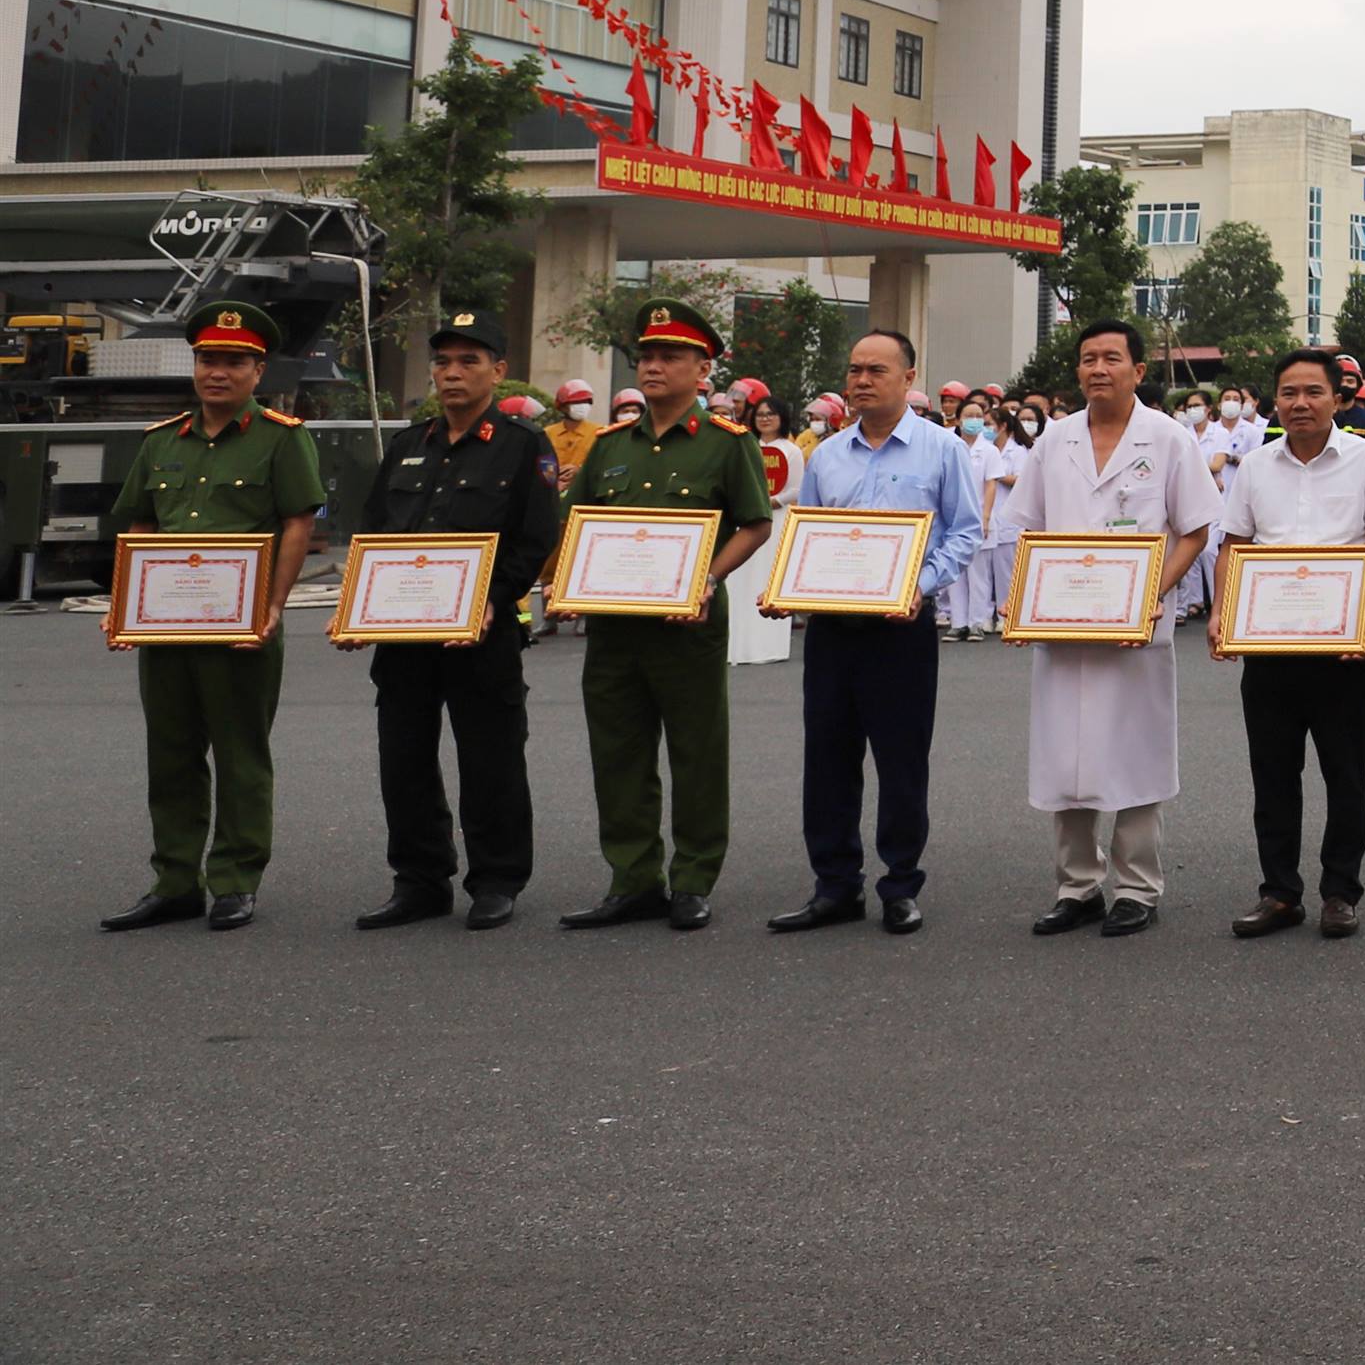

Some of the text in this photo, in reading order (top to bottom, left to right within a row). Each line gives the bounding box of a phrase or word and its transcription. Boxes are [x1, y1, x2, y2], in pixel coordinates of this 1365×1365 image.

[605, 155, 631, 185] NHIỆT
[633, 158, 651, 188] LIỆT
[738, 176, 748, 199] VÀ
[749, 178, 766, 201] CÁC
